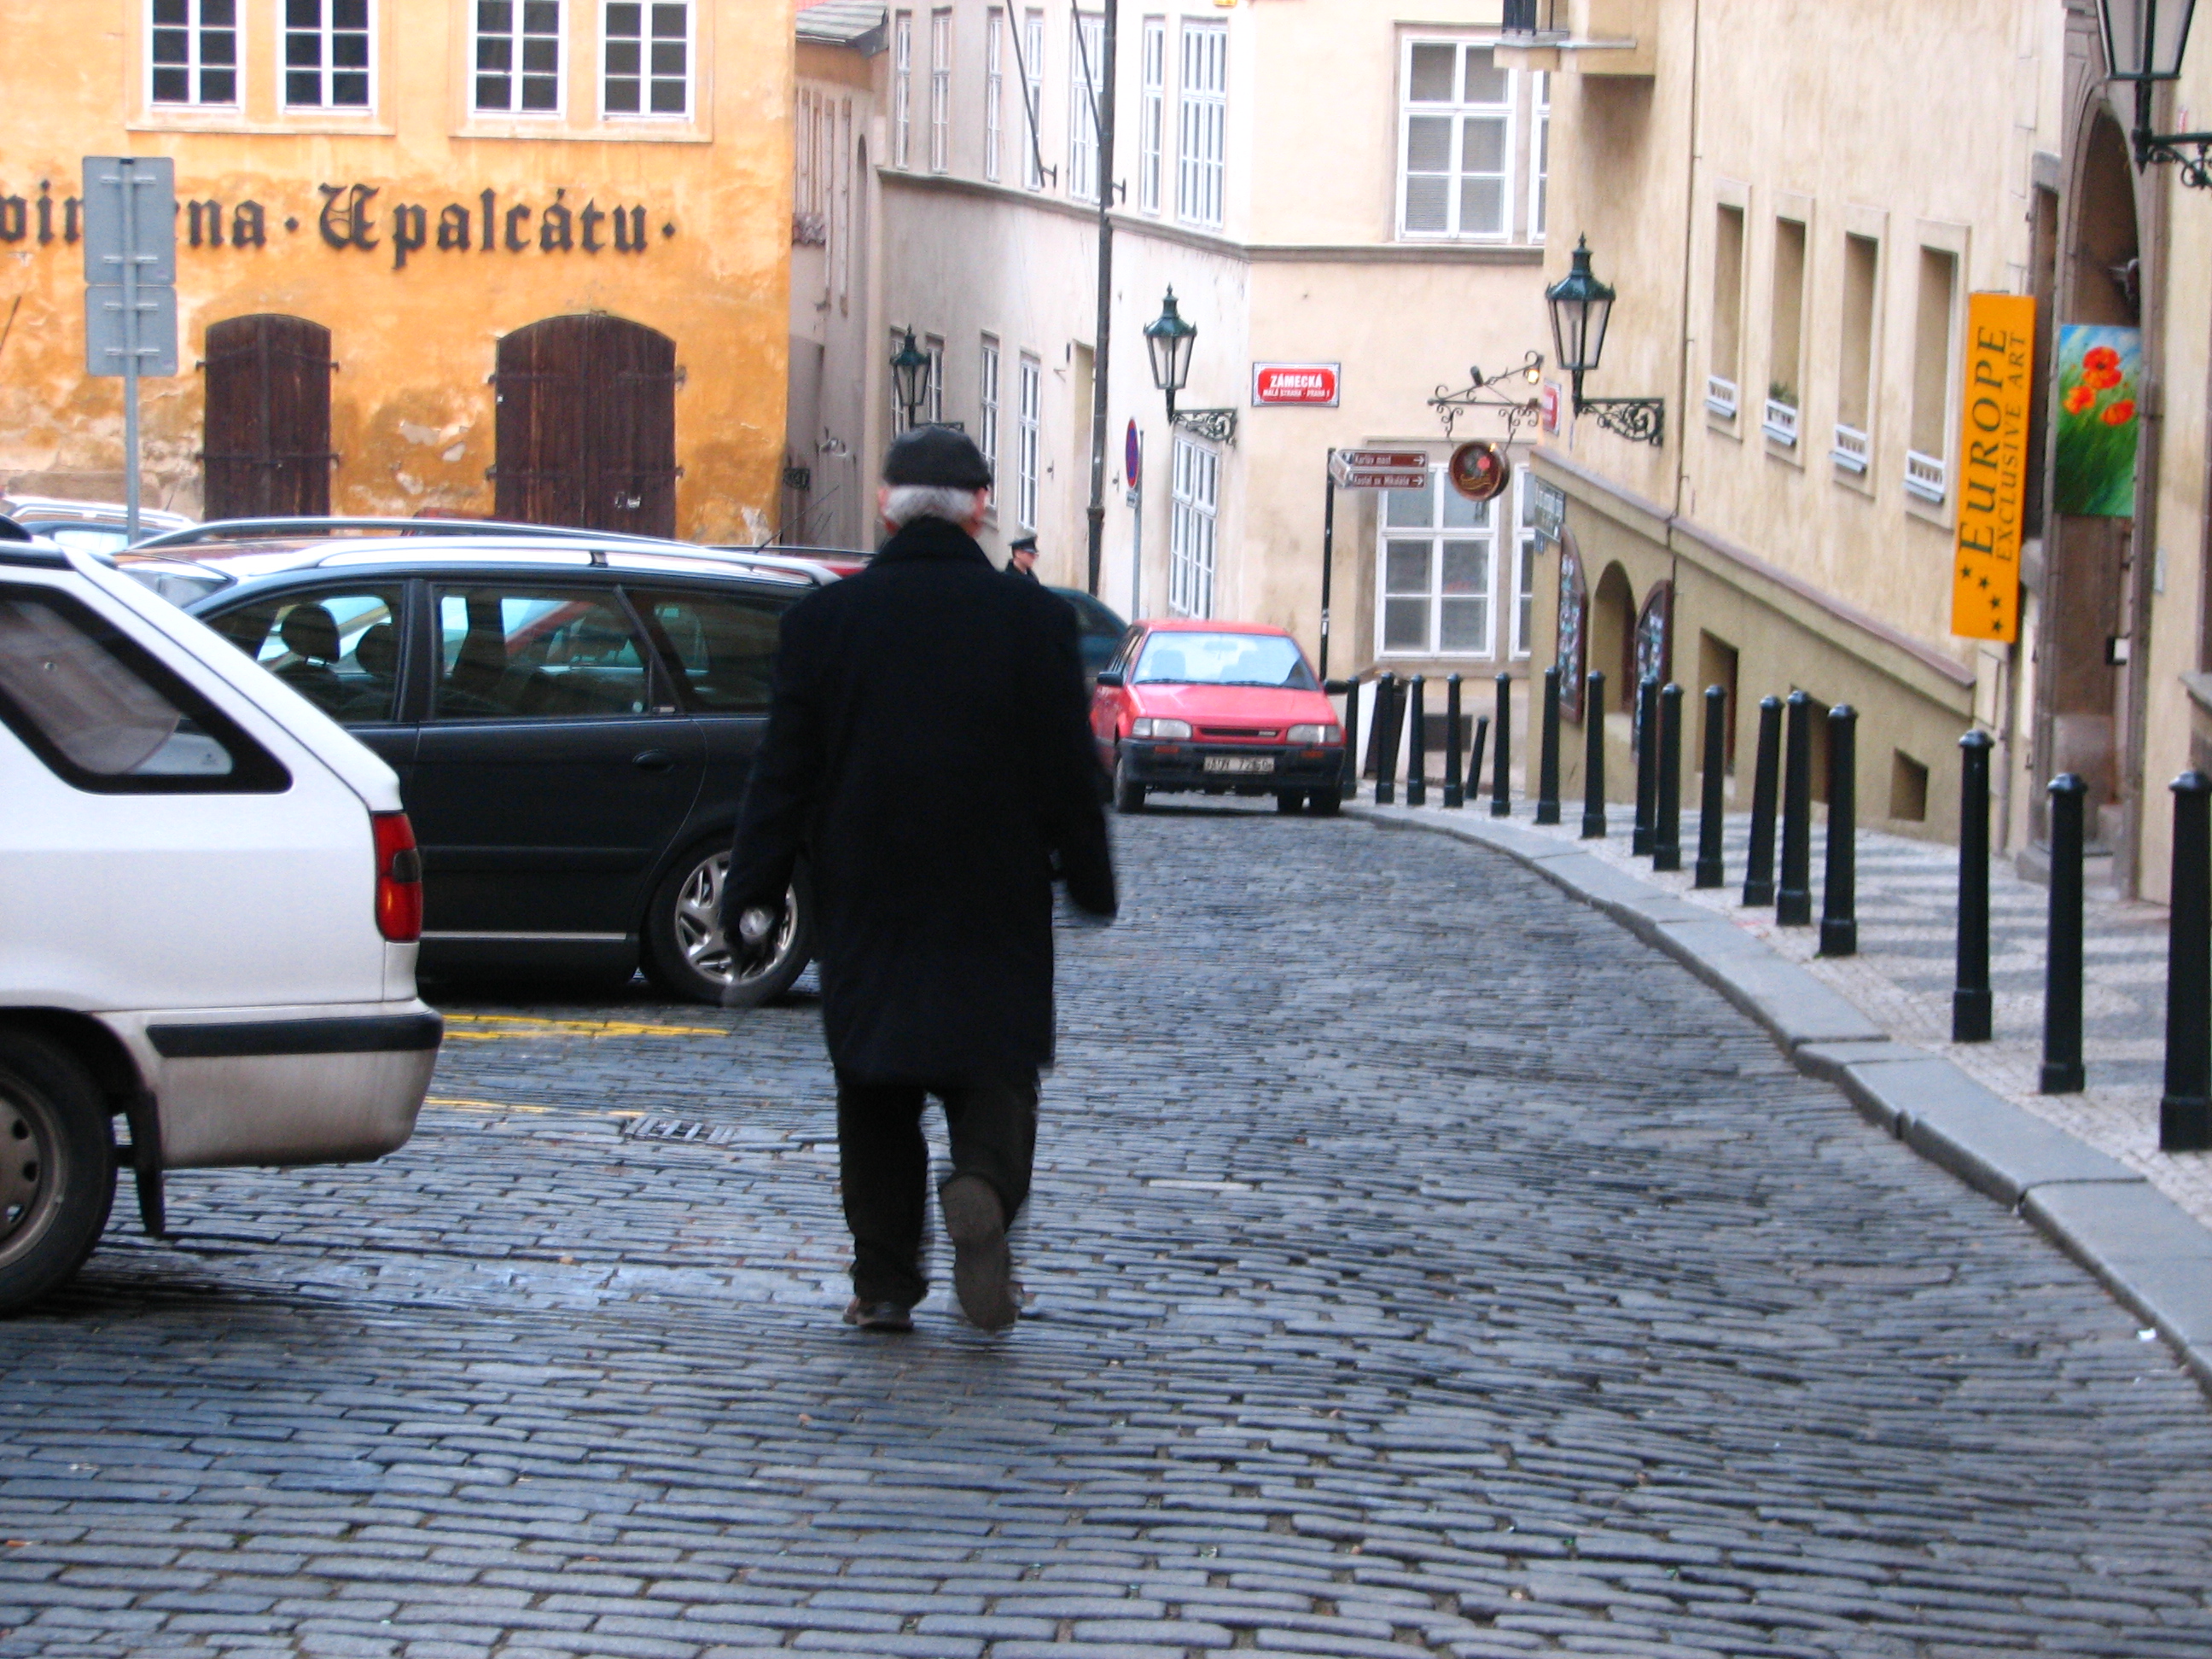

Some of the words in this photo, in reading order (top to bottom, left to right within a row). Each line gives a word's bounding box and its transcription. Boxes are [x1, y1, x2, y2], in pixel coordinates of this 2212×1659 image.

[0, 178, 266, 248] vinna
[1270, 373, 1323, 388] ZÁMECKÁ
[2008, 332, 2026, 388] ART
[1959, 326, 2007, 556] EUROPE
[1996, 404, 2022, 562] EXCLUSIVE
